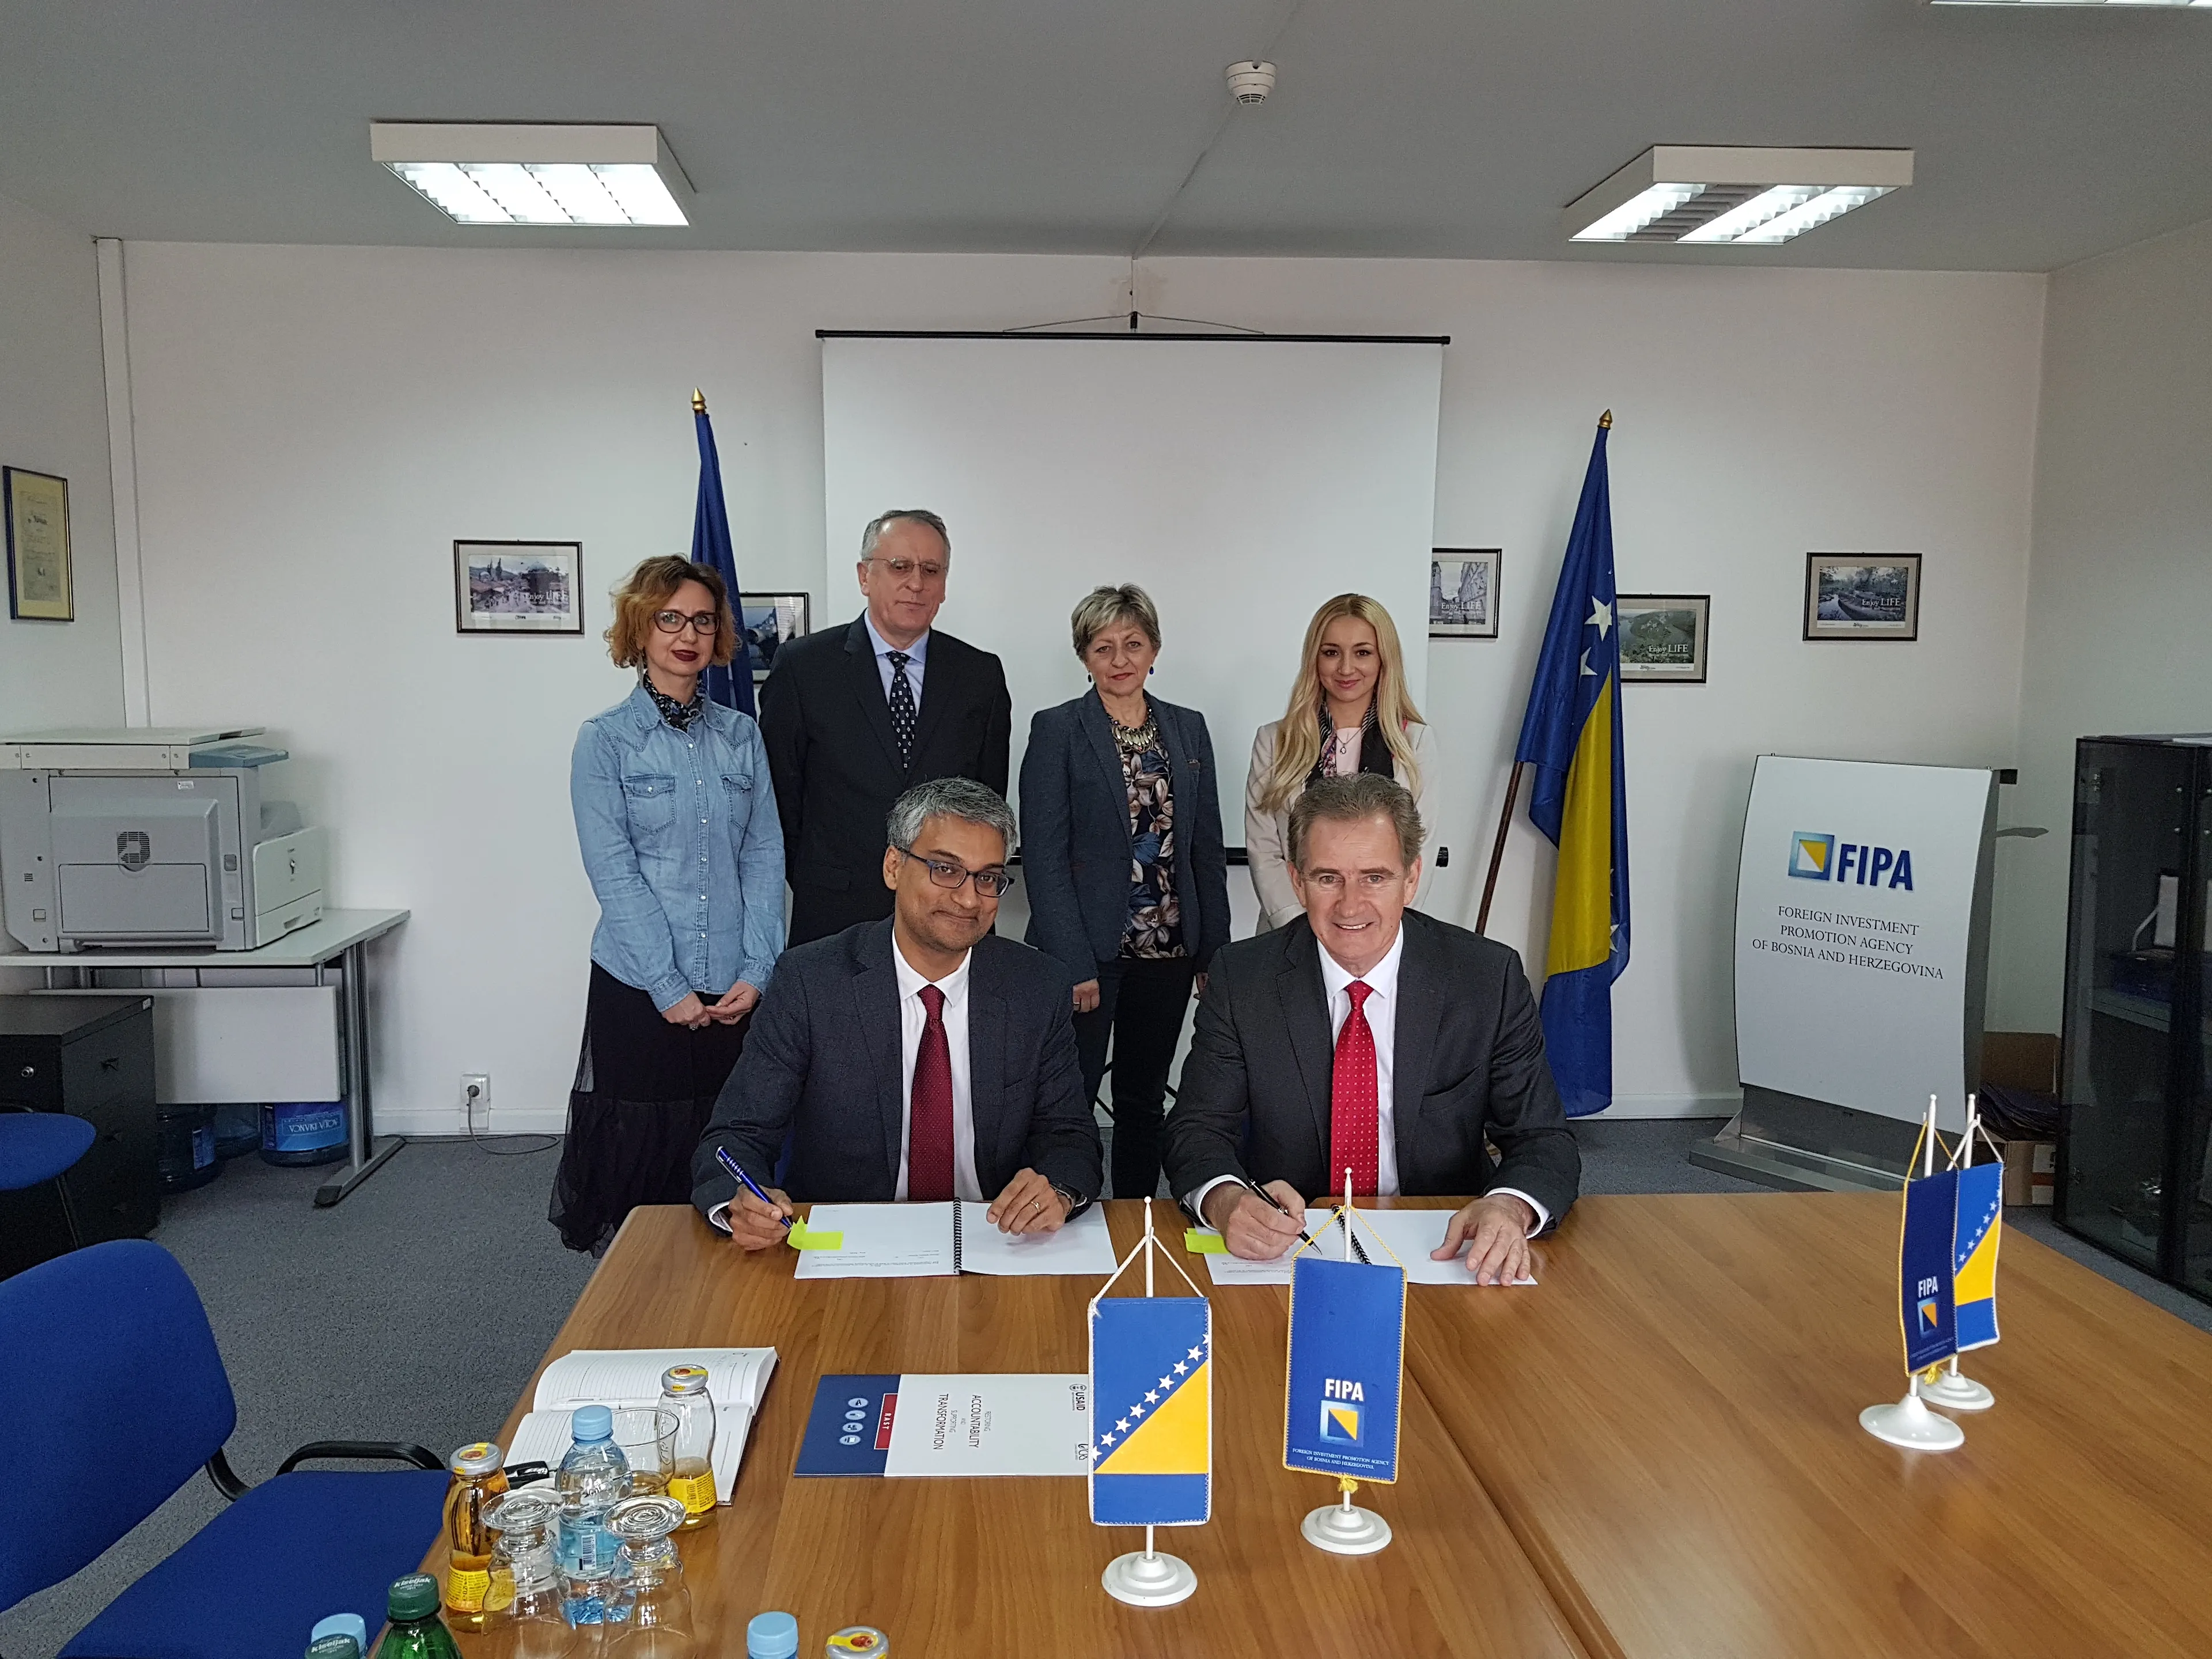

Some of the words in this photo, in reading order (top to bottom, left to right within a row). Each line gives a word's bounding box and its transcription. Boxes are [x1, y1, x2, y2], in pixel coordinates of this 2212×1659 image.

[1441, 603, 1459, 611] Enjoy
[1461, 601, 1482, 609] LIFE
[1862, 599, 1879, 607] Enjoy
[1881, 598, 1901, 606] LIFE
[1649, 646, 1666, 654] Enjoy
[1668, 644, 1688, 653] LIFE
[1837, 843, 1913, 891] FIPA
[1778, 906, 1832, 923] FOREIGN
[1836, 914, 1919, 935] INVESTMENT
[1781, 925, 1857, 946] PROMOTION
[1860, 937, 1913, 955] AGENCY
[1752, 938, 1768, 950] OF
[1771, 941, 1815, 959] BOSNIA
[1818, 949, 1845, 963] AND
[1849, 954, 1944, 979] HERZEGOVINA
[1918, 1276, 1938, 1298] FIPA
[1325, 1378, 1364, 1402] FIPA
[1075, 1392, 1085, 1411] USAID
[882, 1412, 892, 1430] RAST
[933, 1393, 949, 1450] TRANSFORMATION
[969, 1395, 982, 1448] ACCOUNTABILITY
[1313, 1450, 1342, 1460] INVESTMENT
[1342, 1455, 1370, 1463] PROMOTION
[1342, 1461, 1374, 1469] HERZEGOVINA
